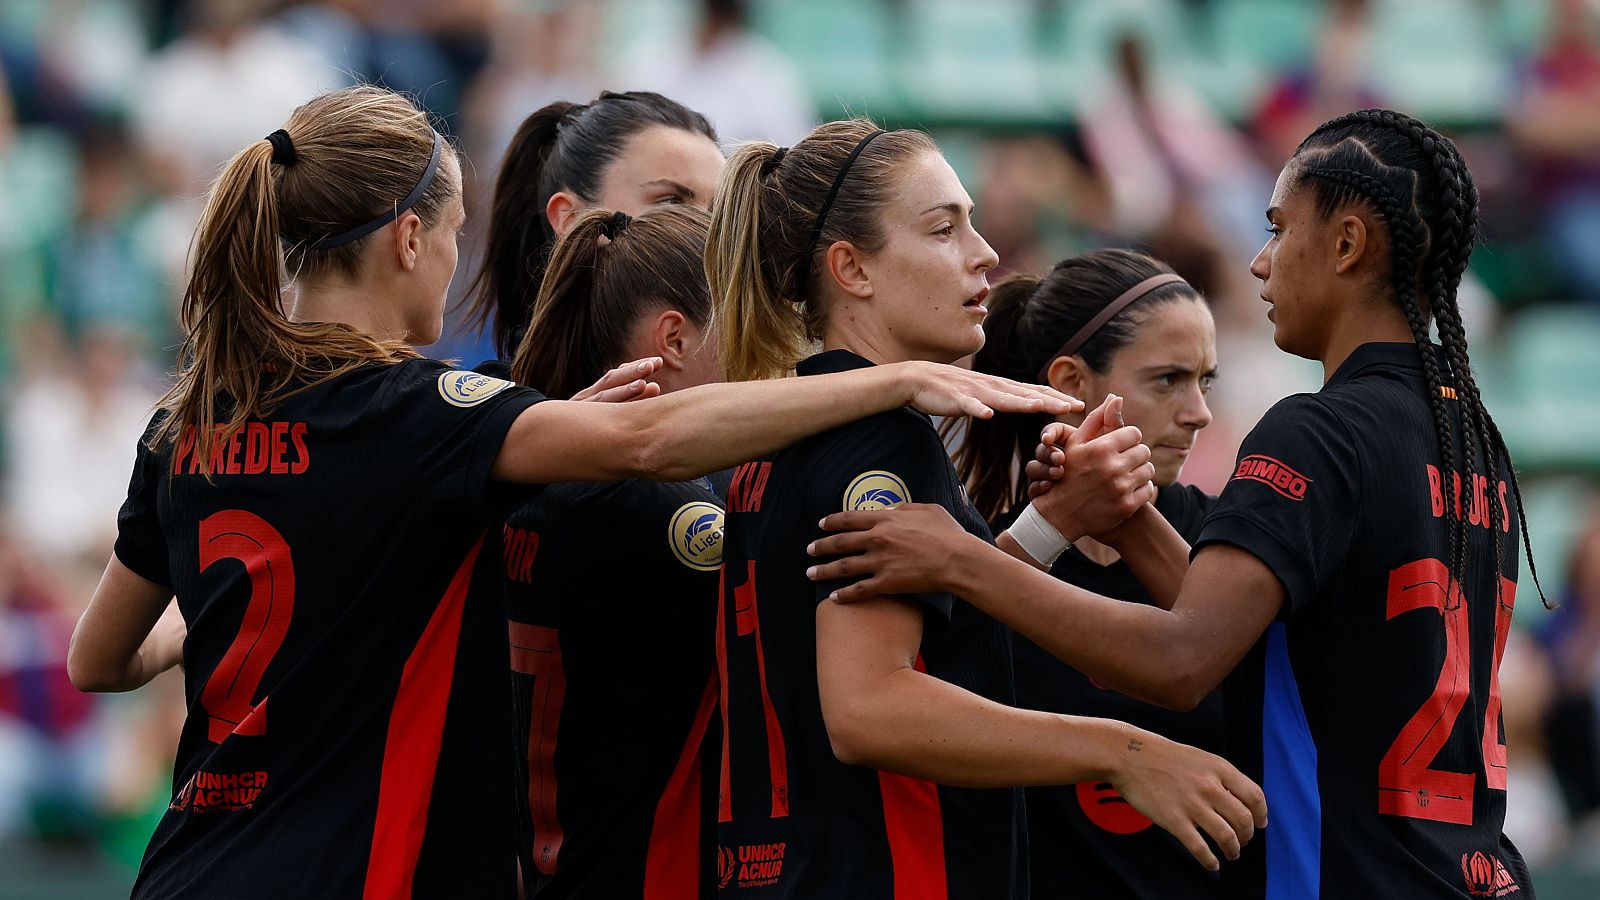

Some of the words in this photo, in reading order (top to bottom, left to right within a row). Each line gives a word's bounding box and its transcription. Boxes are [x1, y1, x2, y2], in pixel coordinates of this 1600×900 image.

[174, 421, 310, 475] PAREDES
[1235, 460, 1307, 497] BIMBO
[199, 508, 296, 745] 2
[196, 770, 269, 790] UNHCR
[739, 842, 786, 862] UNHCR
[738, 860, 783, 880] ACNUR
